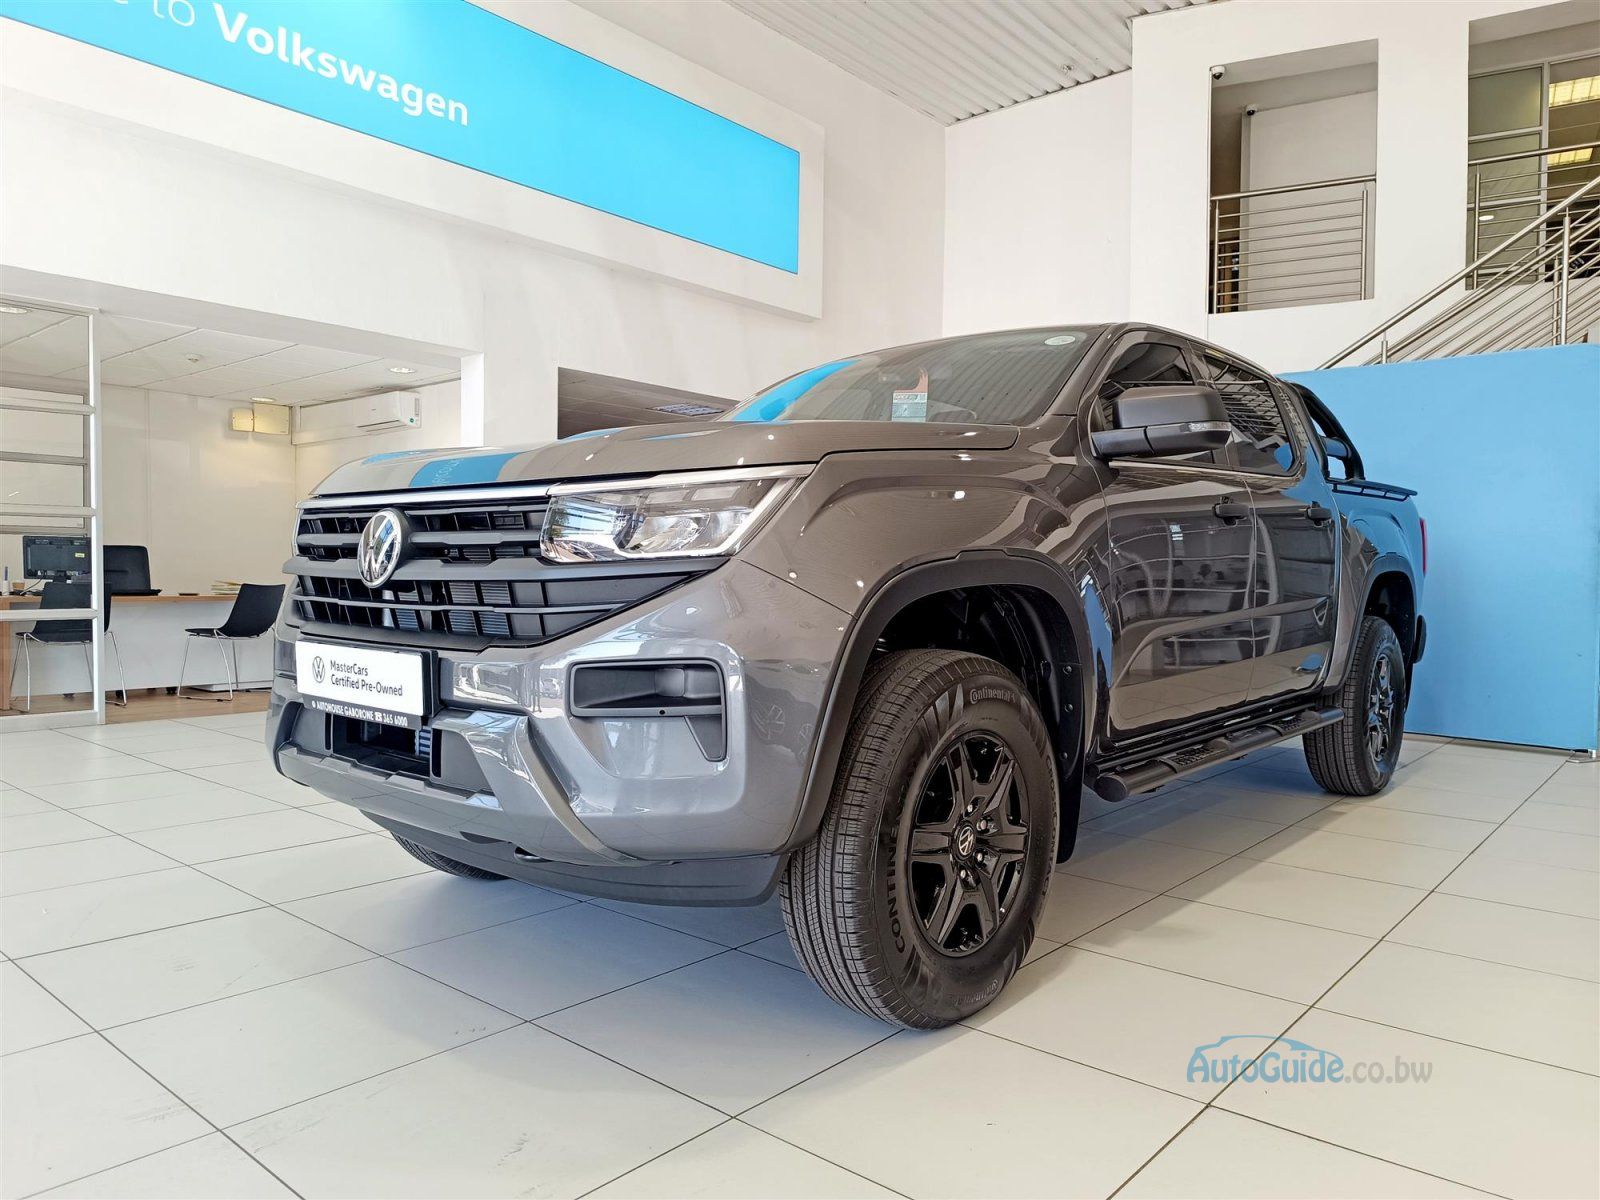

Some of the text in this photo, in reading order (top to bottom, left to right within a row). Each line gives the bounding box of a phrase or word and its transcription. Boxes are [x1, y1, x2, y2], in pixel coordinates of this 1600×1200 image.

[214, 3, 468, 126] Volkswagen
[330, 660, 369, 676] MasterCars
[331, 674, 403, 697] Certified Pre-Owned
[969, 686, 1012, 705] Continental
[344, 706, 374, 721] GABORONE
